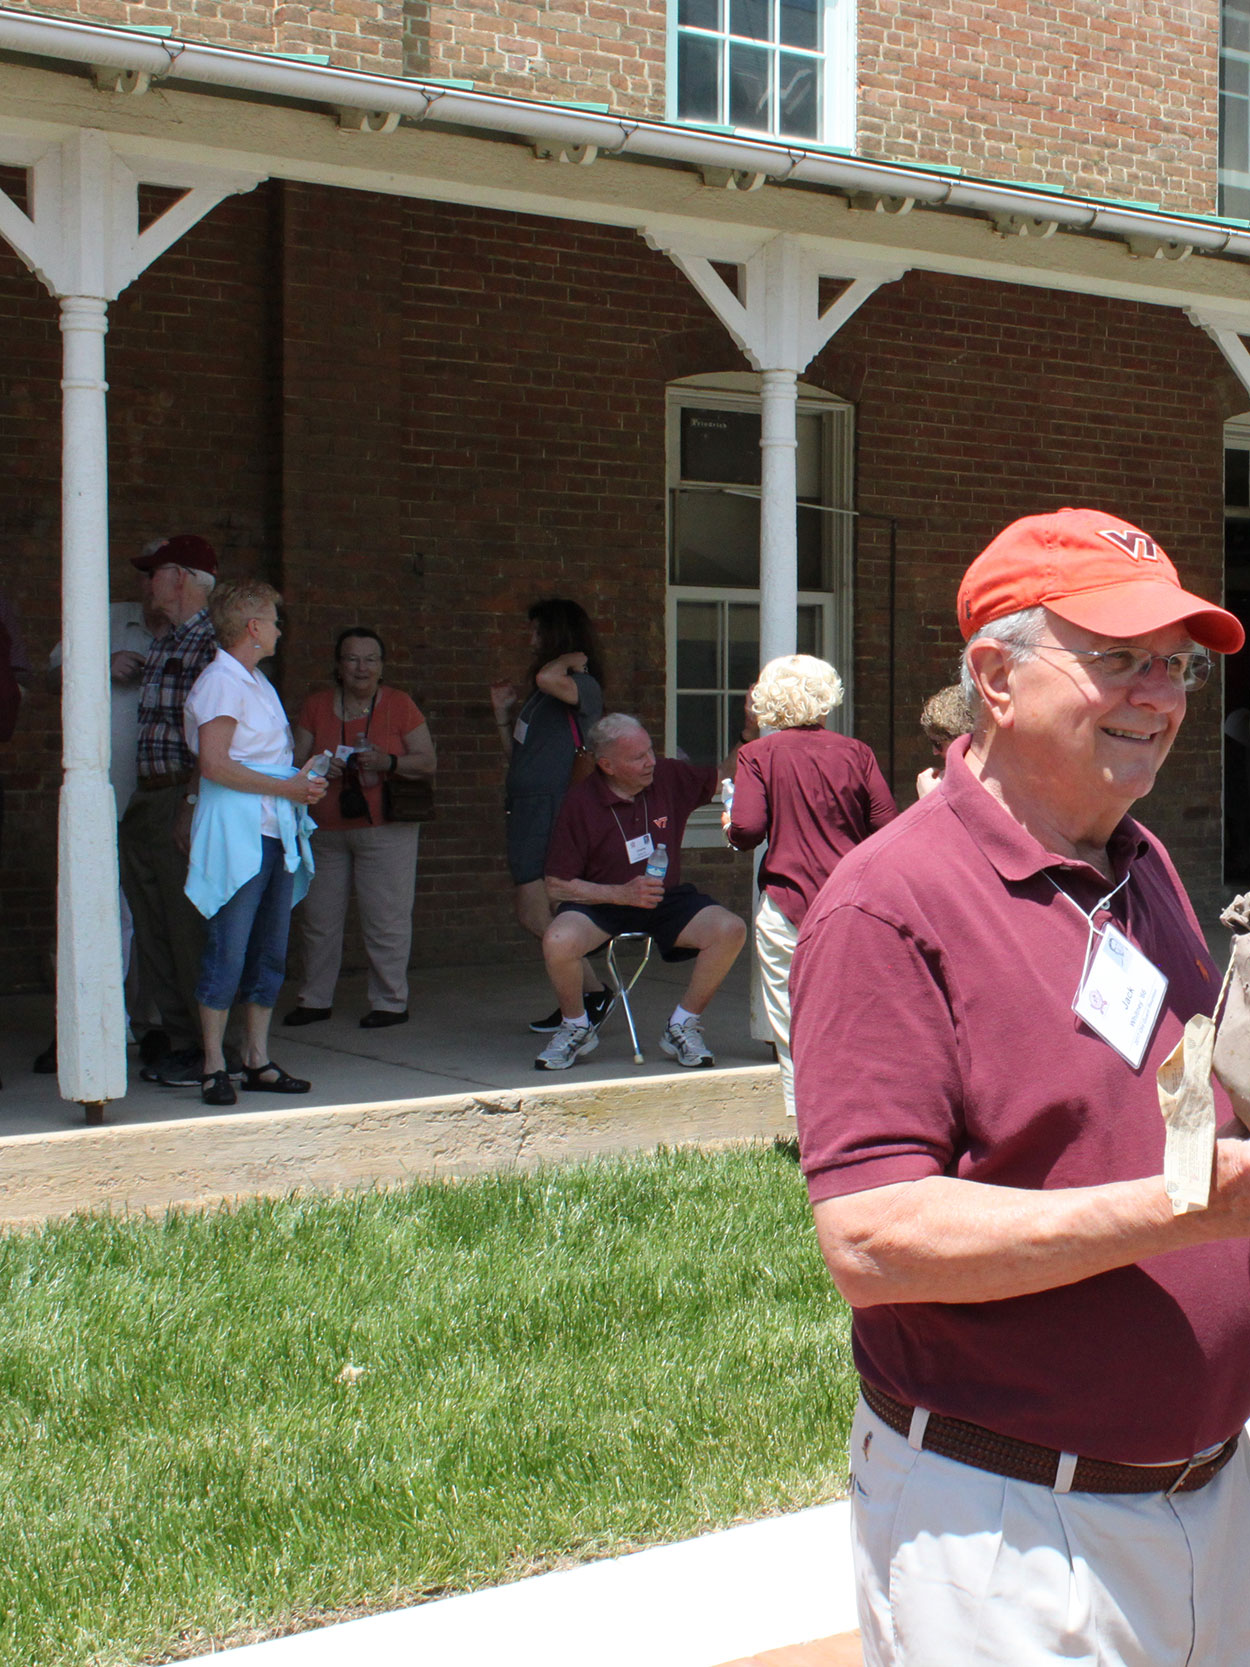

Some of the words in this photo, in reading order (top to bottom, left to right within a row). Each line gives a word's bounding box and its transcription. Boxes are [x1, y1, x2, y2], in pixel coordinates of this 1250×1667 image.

[1096, 529, 1157, 561] VT
[653, 816, 668, 829] VT
[1122, 986, 1134, 1010] Jack
